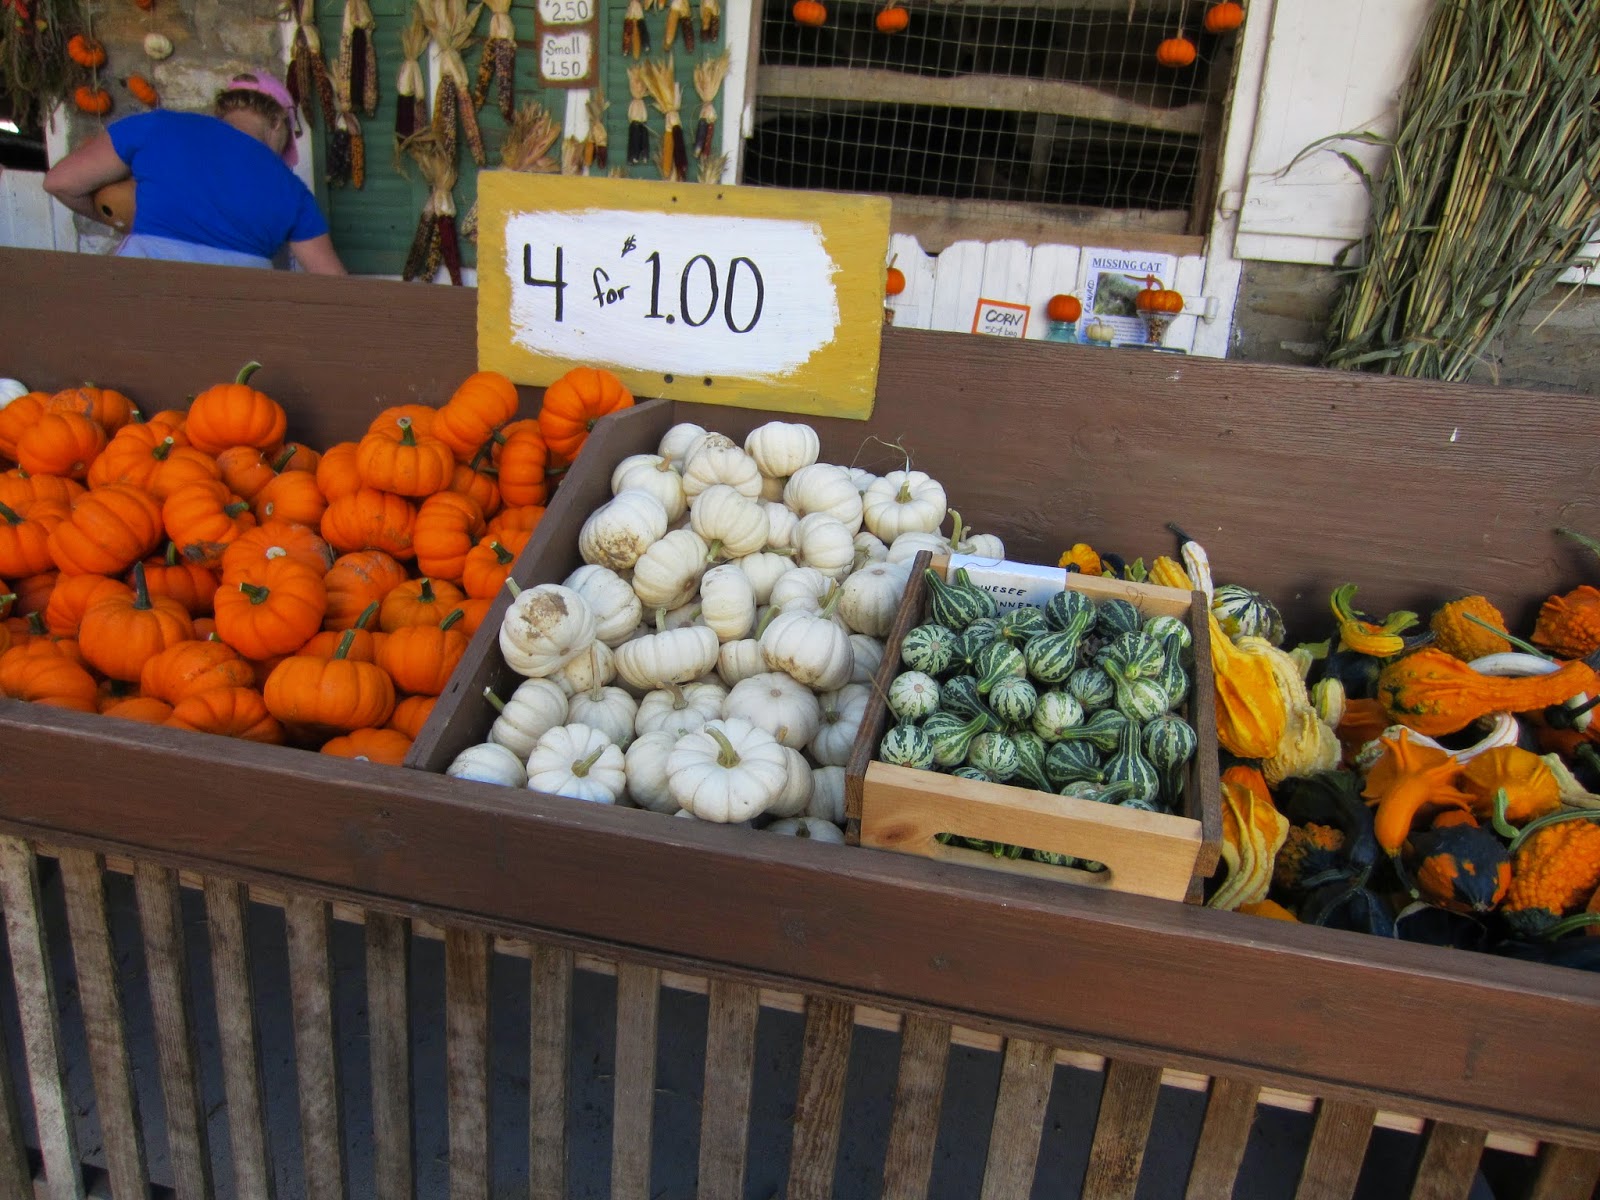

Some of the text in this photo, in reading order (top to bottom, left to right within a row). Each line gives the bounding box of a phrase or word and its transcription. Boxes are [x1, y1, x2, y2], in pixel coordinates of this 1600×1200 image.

[545, 36, 580, 56] Small
[1092, 258, 1162, 273] MISSING CAT
[524, 234, 764, 333] 4 for $1.00
[985, 309, 1024, 326] CORN
[981, 585, 1027, 596] NESEE
